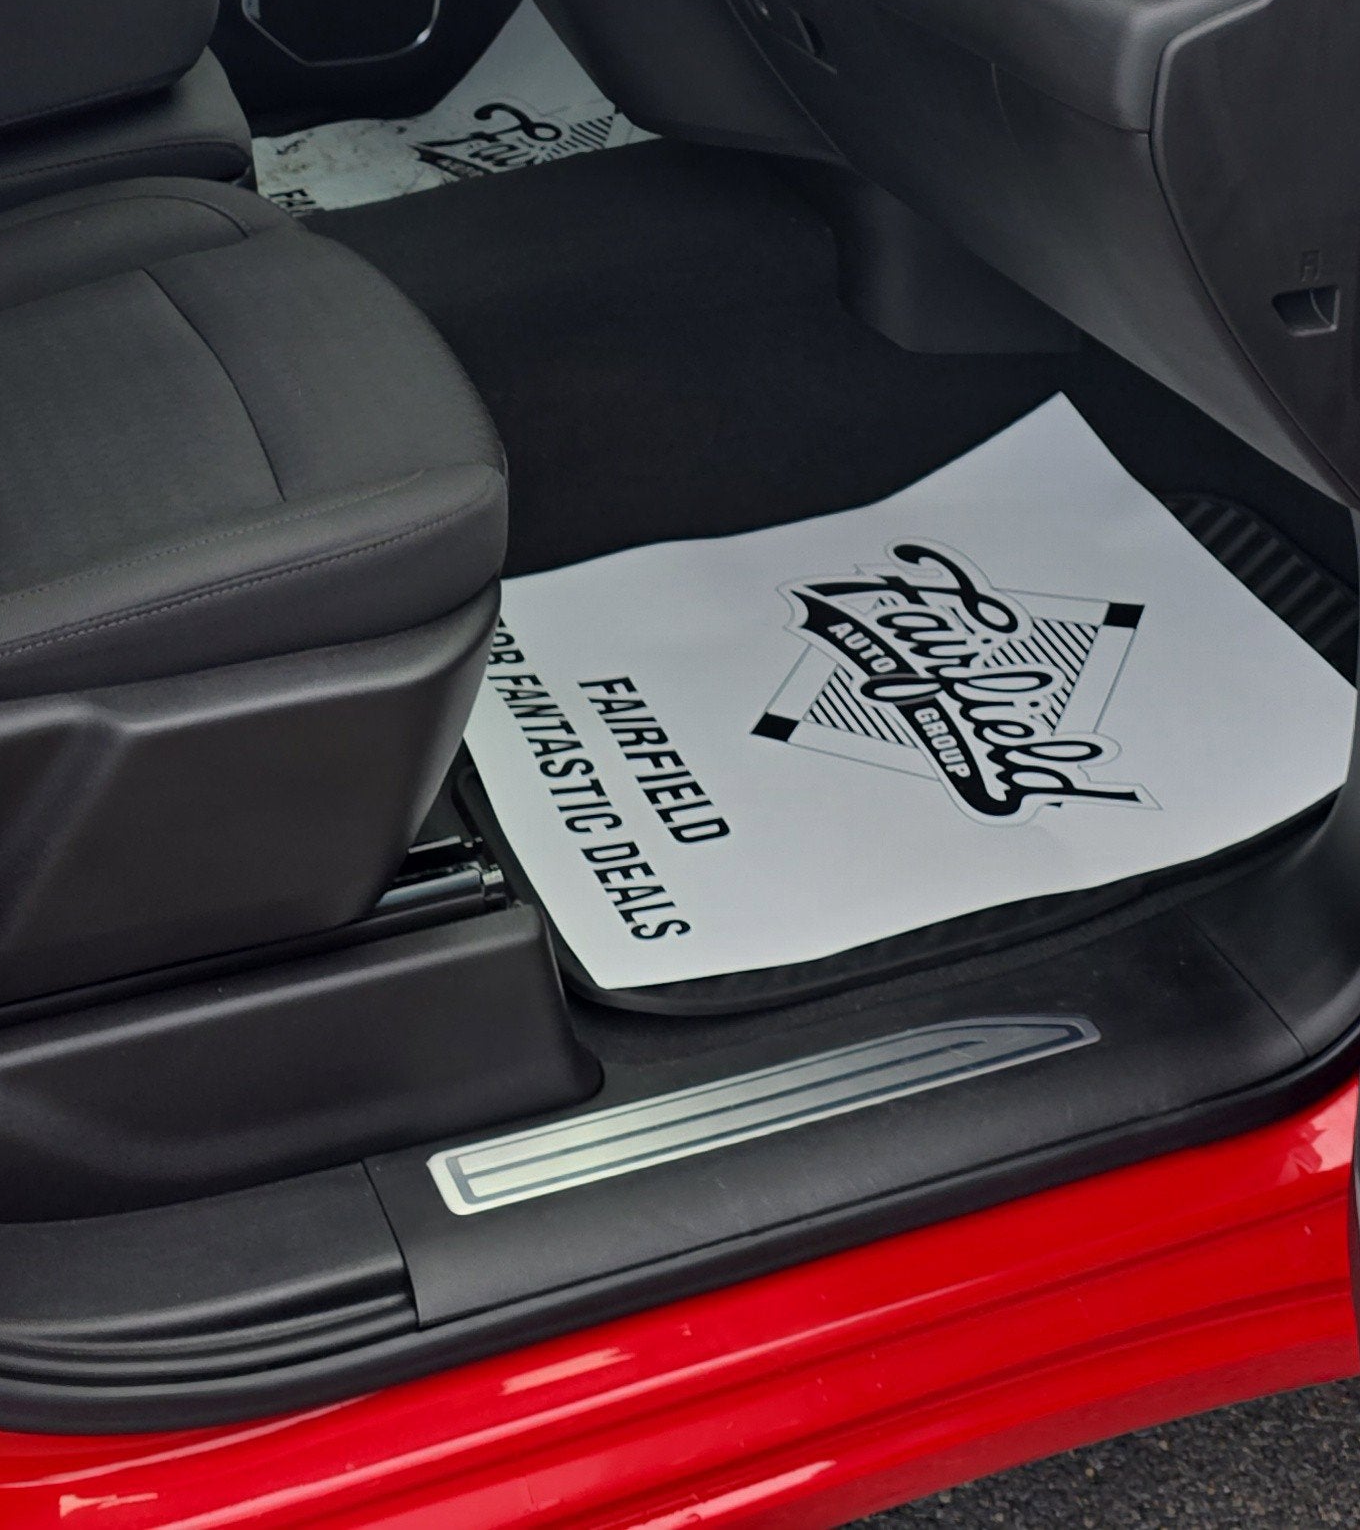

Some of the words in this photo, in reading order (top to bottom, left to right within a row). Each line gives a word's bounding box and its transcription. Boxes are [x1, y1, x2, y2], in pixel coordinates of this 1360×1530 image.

[577, 676, 732, 844] FAIRFIELD
[805, 543, 1143, 808] Fairfield
[827, 621, 899, 675] AUTO
[913, 705, 972, 779] GROUP
[486, 673, 624, 835] FANTASTIC
[581, 841, 692, 941] DEALS
